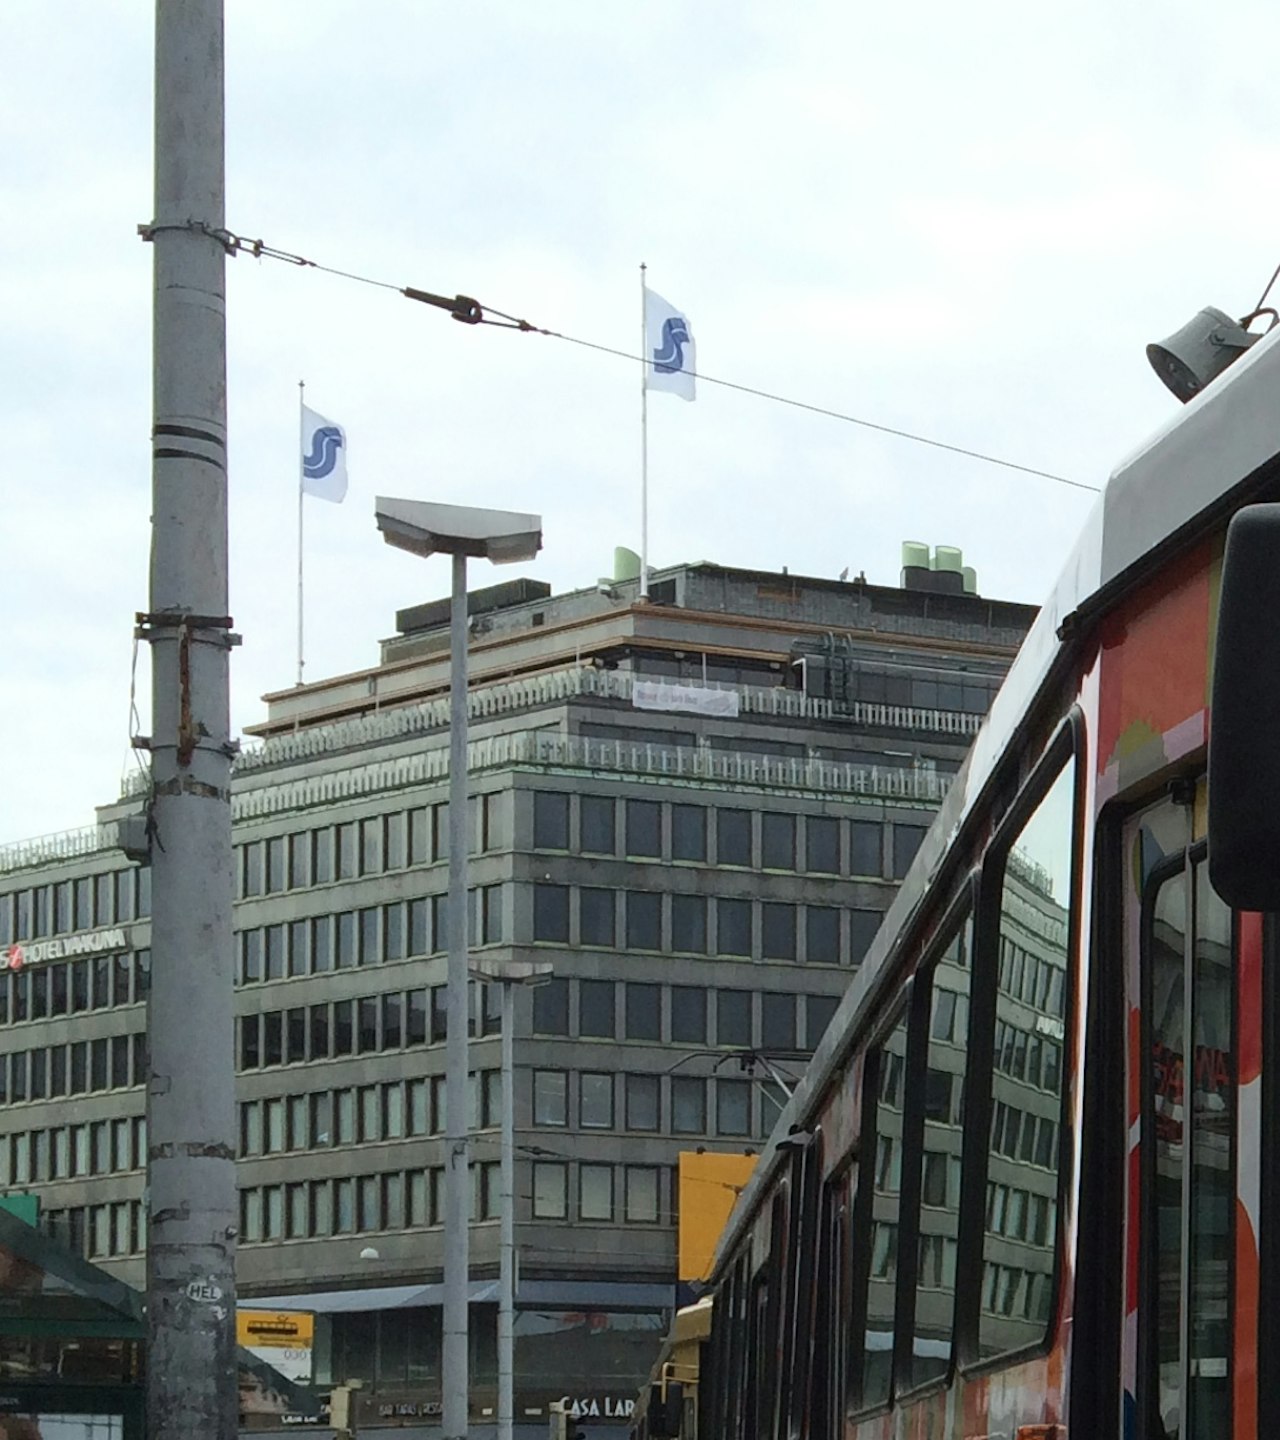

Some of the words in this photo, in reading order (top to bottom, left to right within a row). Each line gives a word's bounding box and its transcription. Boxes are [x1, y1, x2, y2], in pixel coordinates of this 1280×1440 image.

[23, 940, 62, 964] HOTEL
[190, 1285, 217, 1299] HEL
[561, 1396, 600, 1416] CASA
